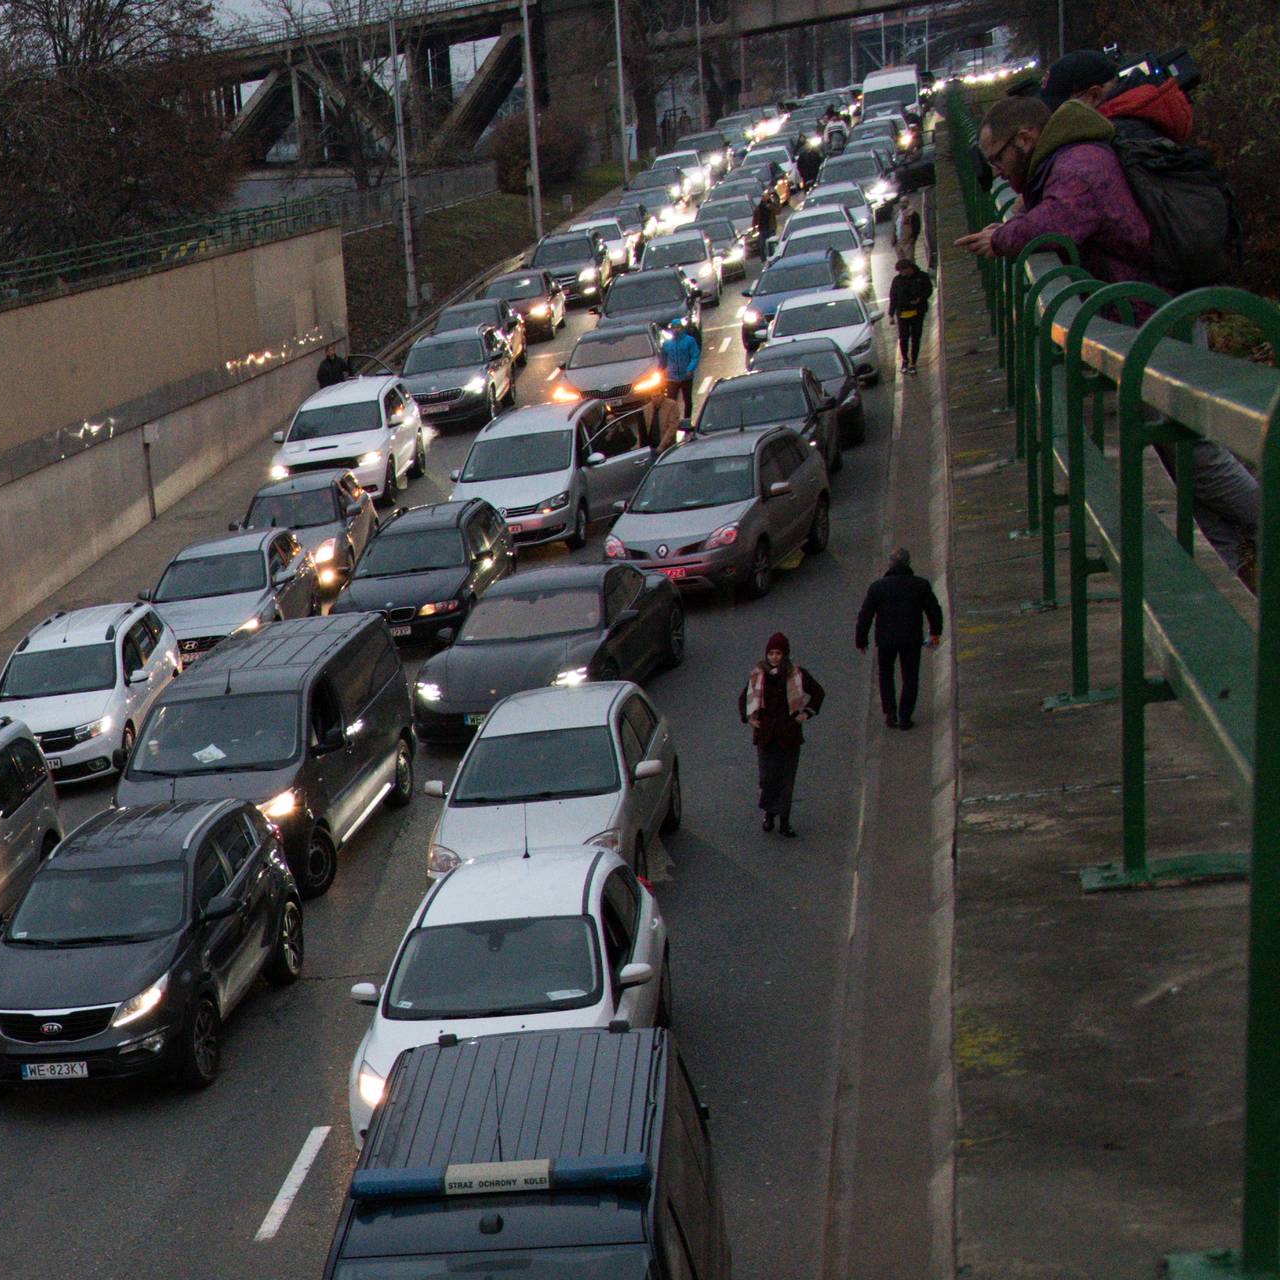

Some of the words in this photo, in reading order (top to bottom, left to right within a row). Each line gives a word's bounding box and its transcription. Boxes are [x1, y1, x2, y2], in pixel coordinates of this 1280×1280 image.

[28, 1064, 46, 1076] WE
[49, 1063, 85, 1076] 823KY
[478, 1178, 517, 1188] OCHRONY
[523, 1177, 548, 1186] KOLEI
